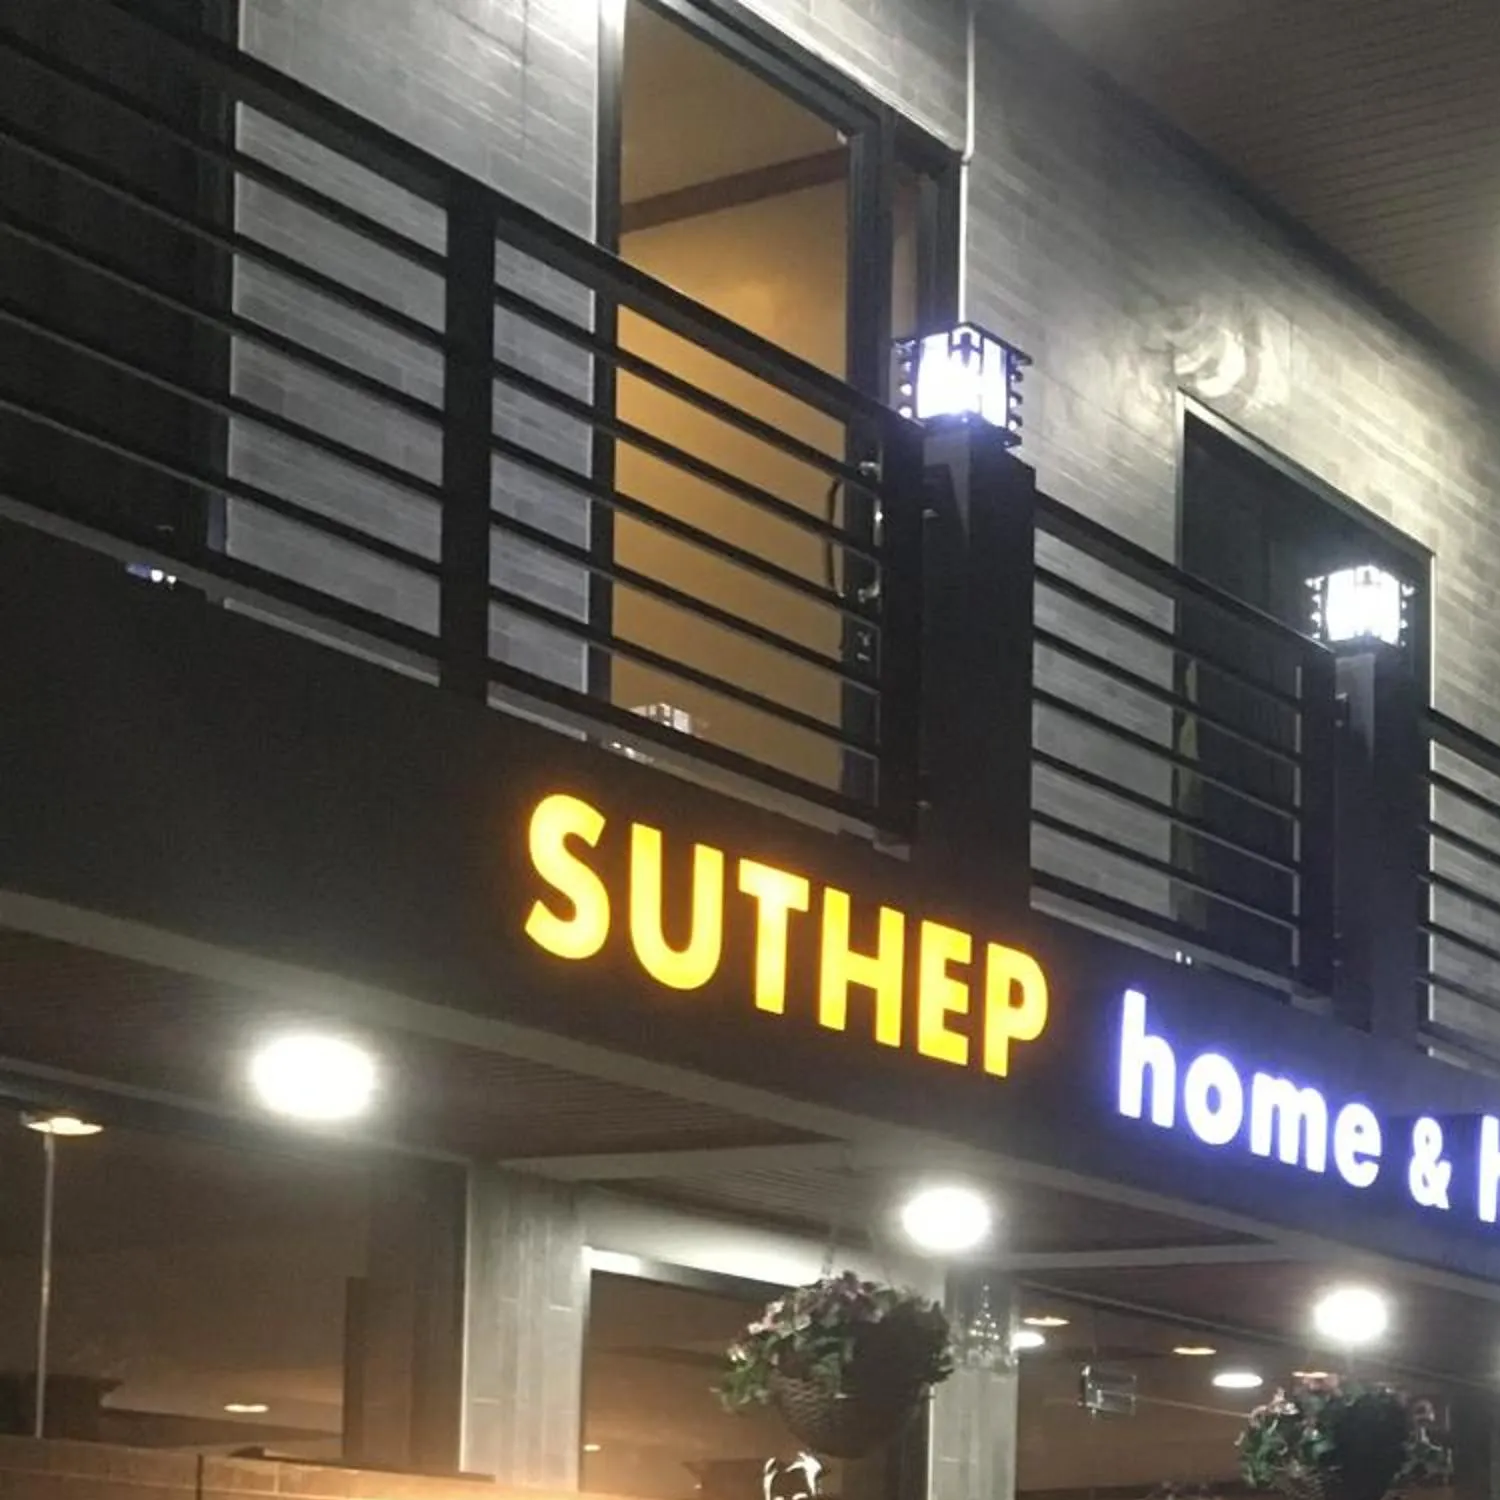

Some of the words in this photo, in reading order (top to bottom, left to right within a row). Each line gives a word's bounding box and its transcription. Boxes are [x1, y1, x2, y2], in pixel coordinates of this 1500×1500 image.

[525, 794, 1048, 1077] SUTHEP
[1118, 988, 1382, 1188] home
[1408, 1117, 1451, 1210] &
